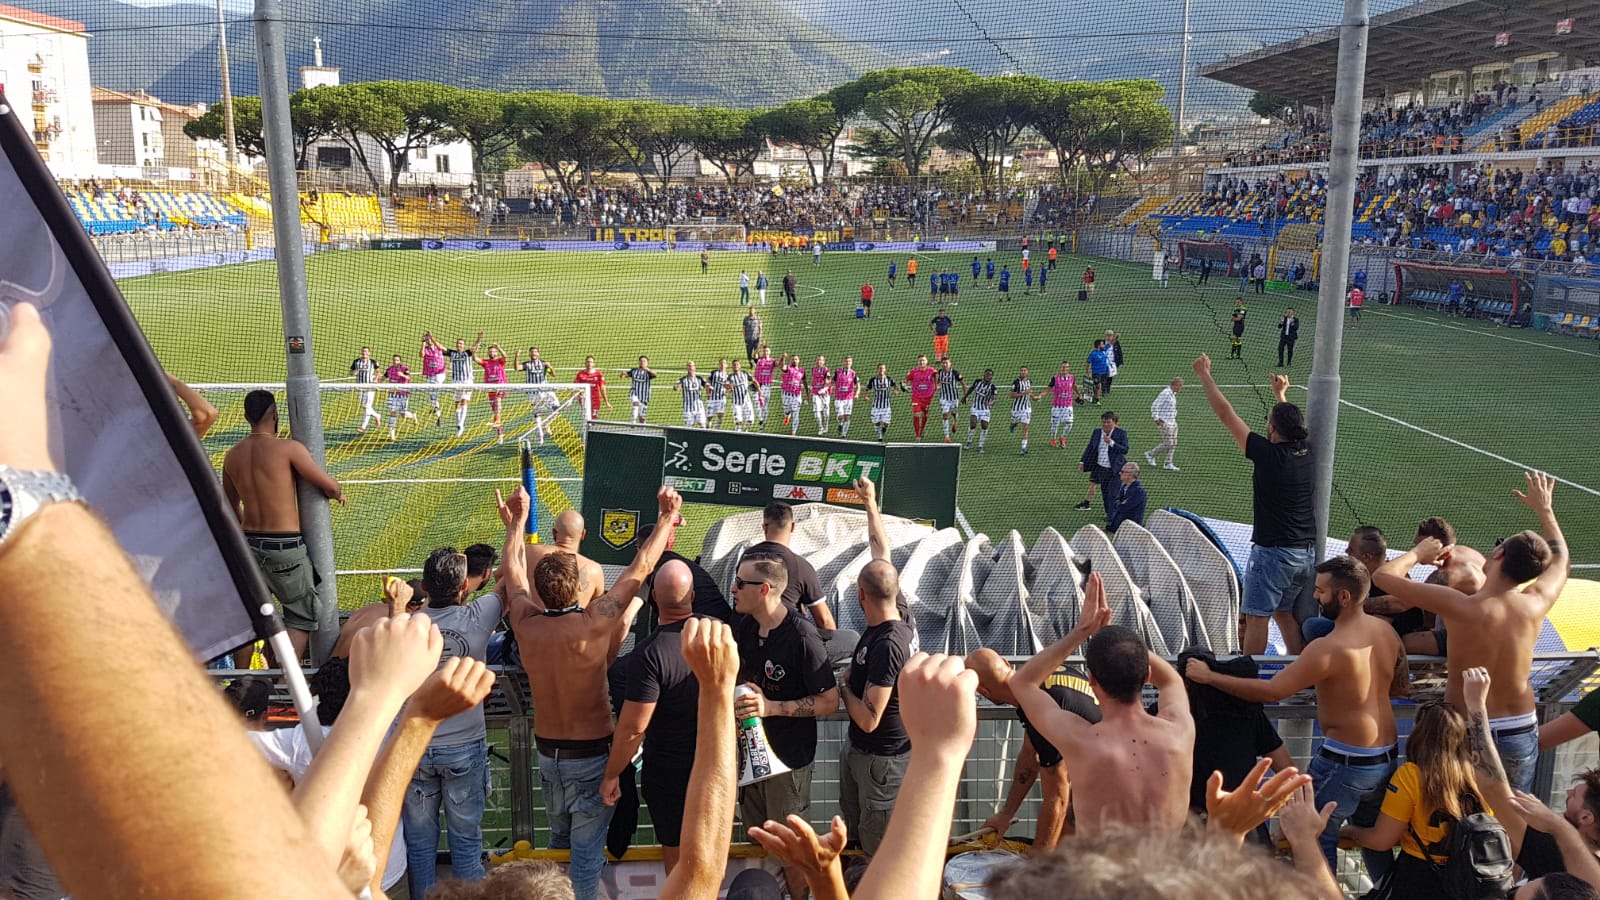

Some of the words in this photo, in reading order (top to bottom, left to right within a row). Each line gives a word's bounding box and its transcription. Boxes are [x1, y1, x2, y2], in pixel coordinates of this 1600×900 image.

[702, 443, 786, 476] Serie
[797, 456, 880, 479] BKT
[674, 480, 706, 490] BKT
